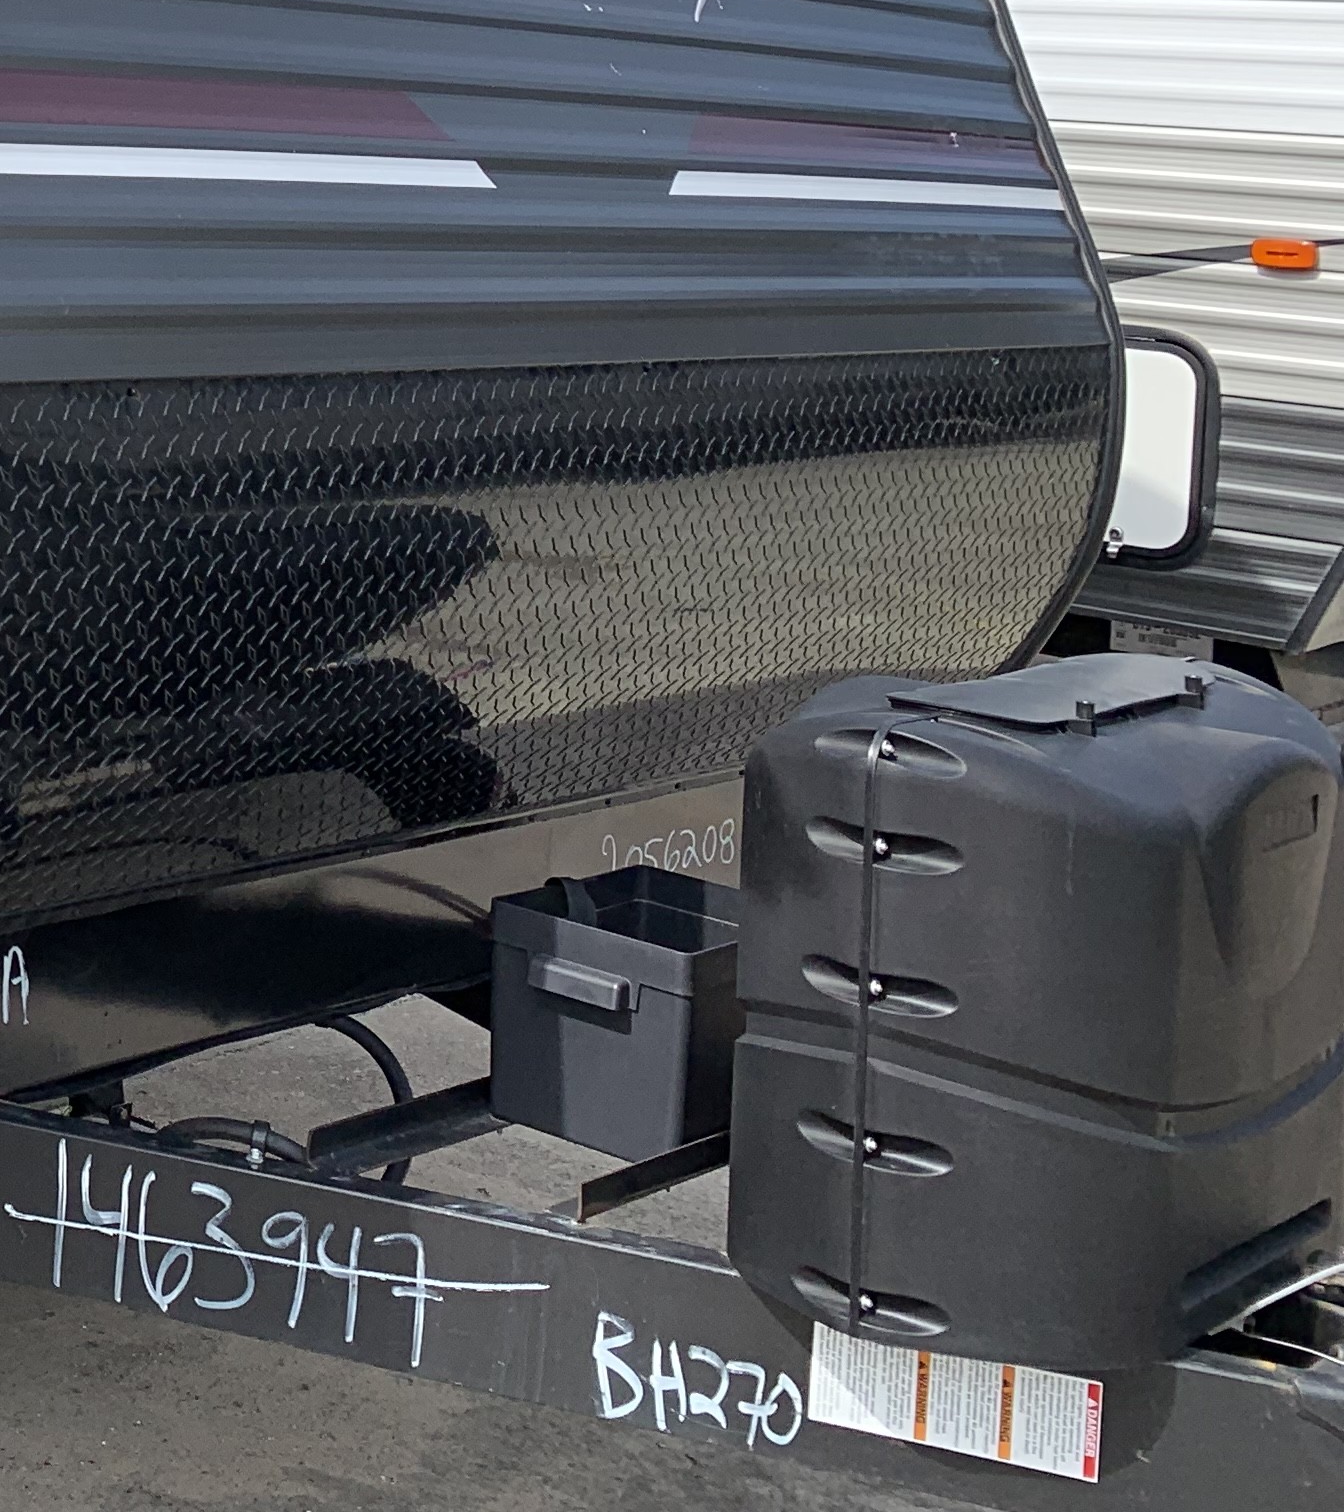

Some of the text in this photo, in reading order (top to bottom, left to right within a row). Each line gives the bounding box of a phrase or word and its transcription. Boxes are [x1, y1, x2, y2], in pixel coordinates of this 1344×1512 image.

[53, 1139, 443, 1367] 1463947
[593, 1311, 804, 1448] BH270
[916, 1373, 929, 1424] WARNING
[999, 1393, 1013, 1443] WARNING
[1084, 1408, 1100, 1458] DANGER
